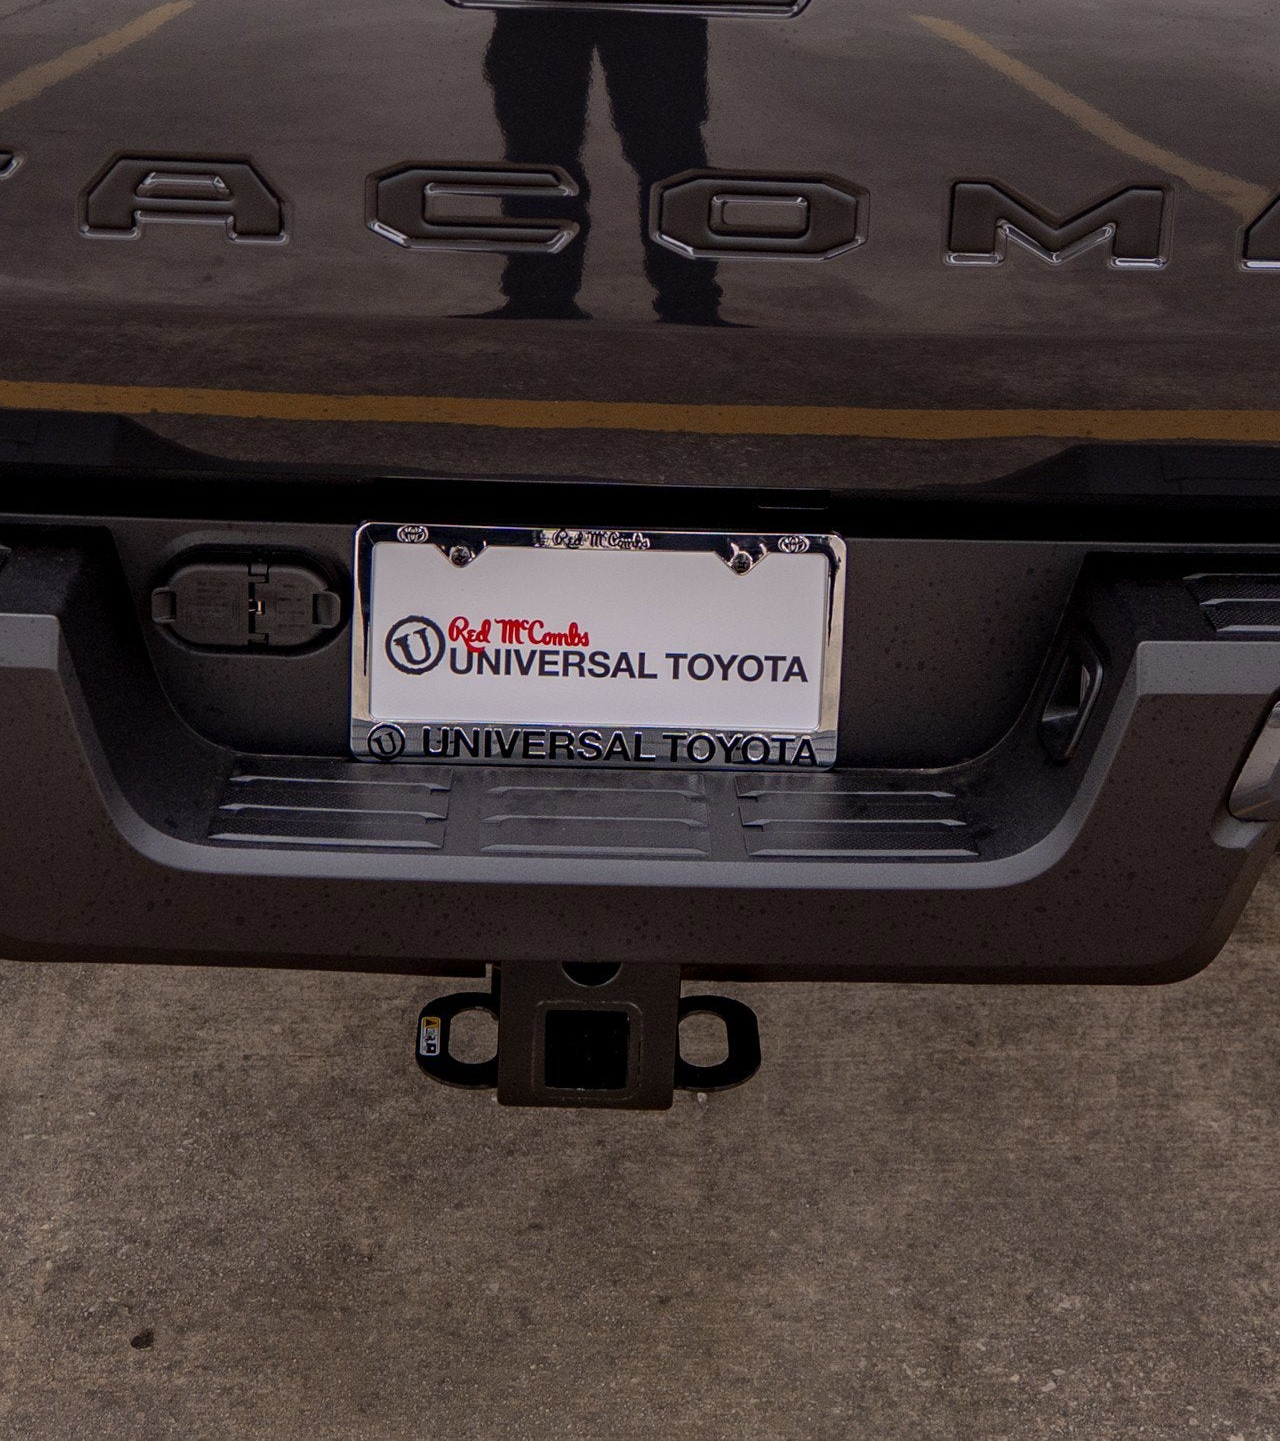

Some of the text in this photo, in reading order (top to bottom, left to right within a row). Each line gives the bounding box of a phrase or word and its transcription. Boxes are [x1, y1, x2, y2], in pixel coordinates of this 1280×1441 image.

[552, 527, 583, 549] Red
[448, 616, 590, 653] Red McCombs
[449, 647, 808, 683] UNIVERSAL TOYOTA
[422, 726, 819, 767] UNIVERSAL TOYOTA
